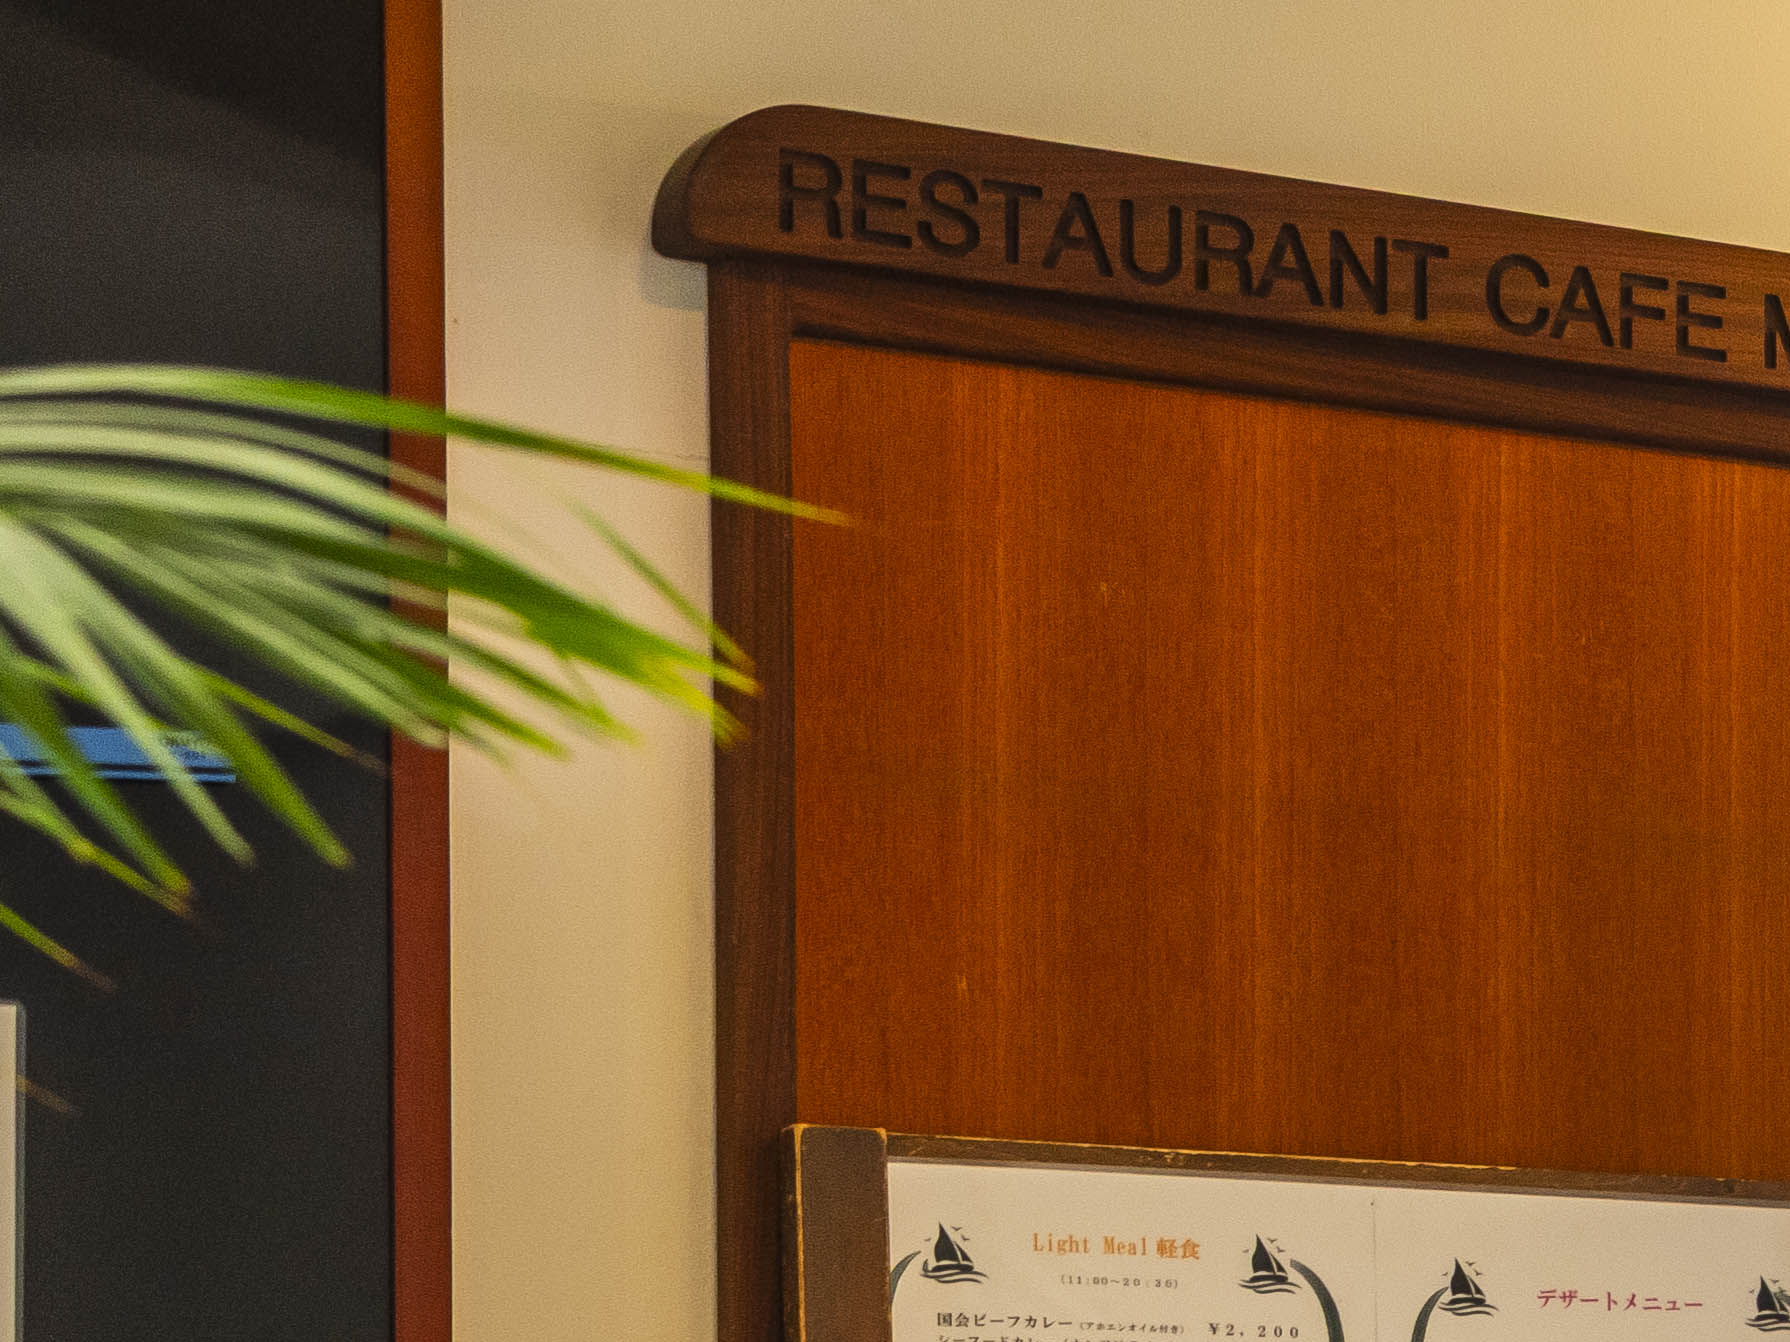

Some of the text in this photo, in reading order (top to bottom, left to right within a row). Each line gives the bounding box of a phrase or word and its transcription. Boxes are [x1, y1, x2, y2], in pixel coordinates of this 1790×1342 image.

[776, 147, 1448, 322] RESTAURANT
[1486, 253, 1728, 363] CAFE
[1033, 1233, 1201, 1260] Light Meal 軽食
[1536, 1289, 1704, 1312] デザートメニュー
[937, 1312, 1073, 1329] 国会ビーフカレー
